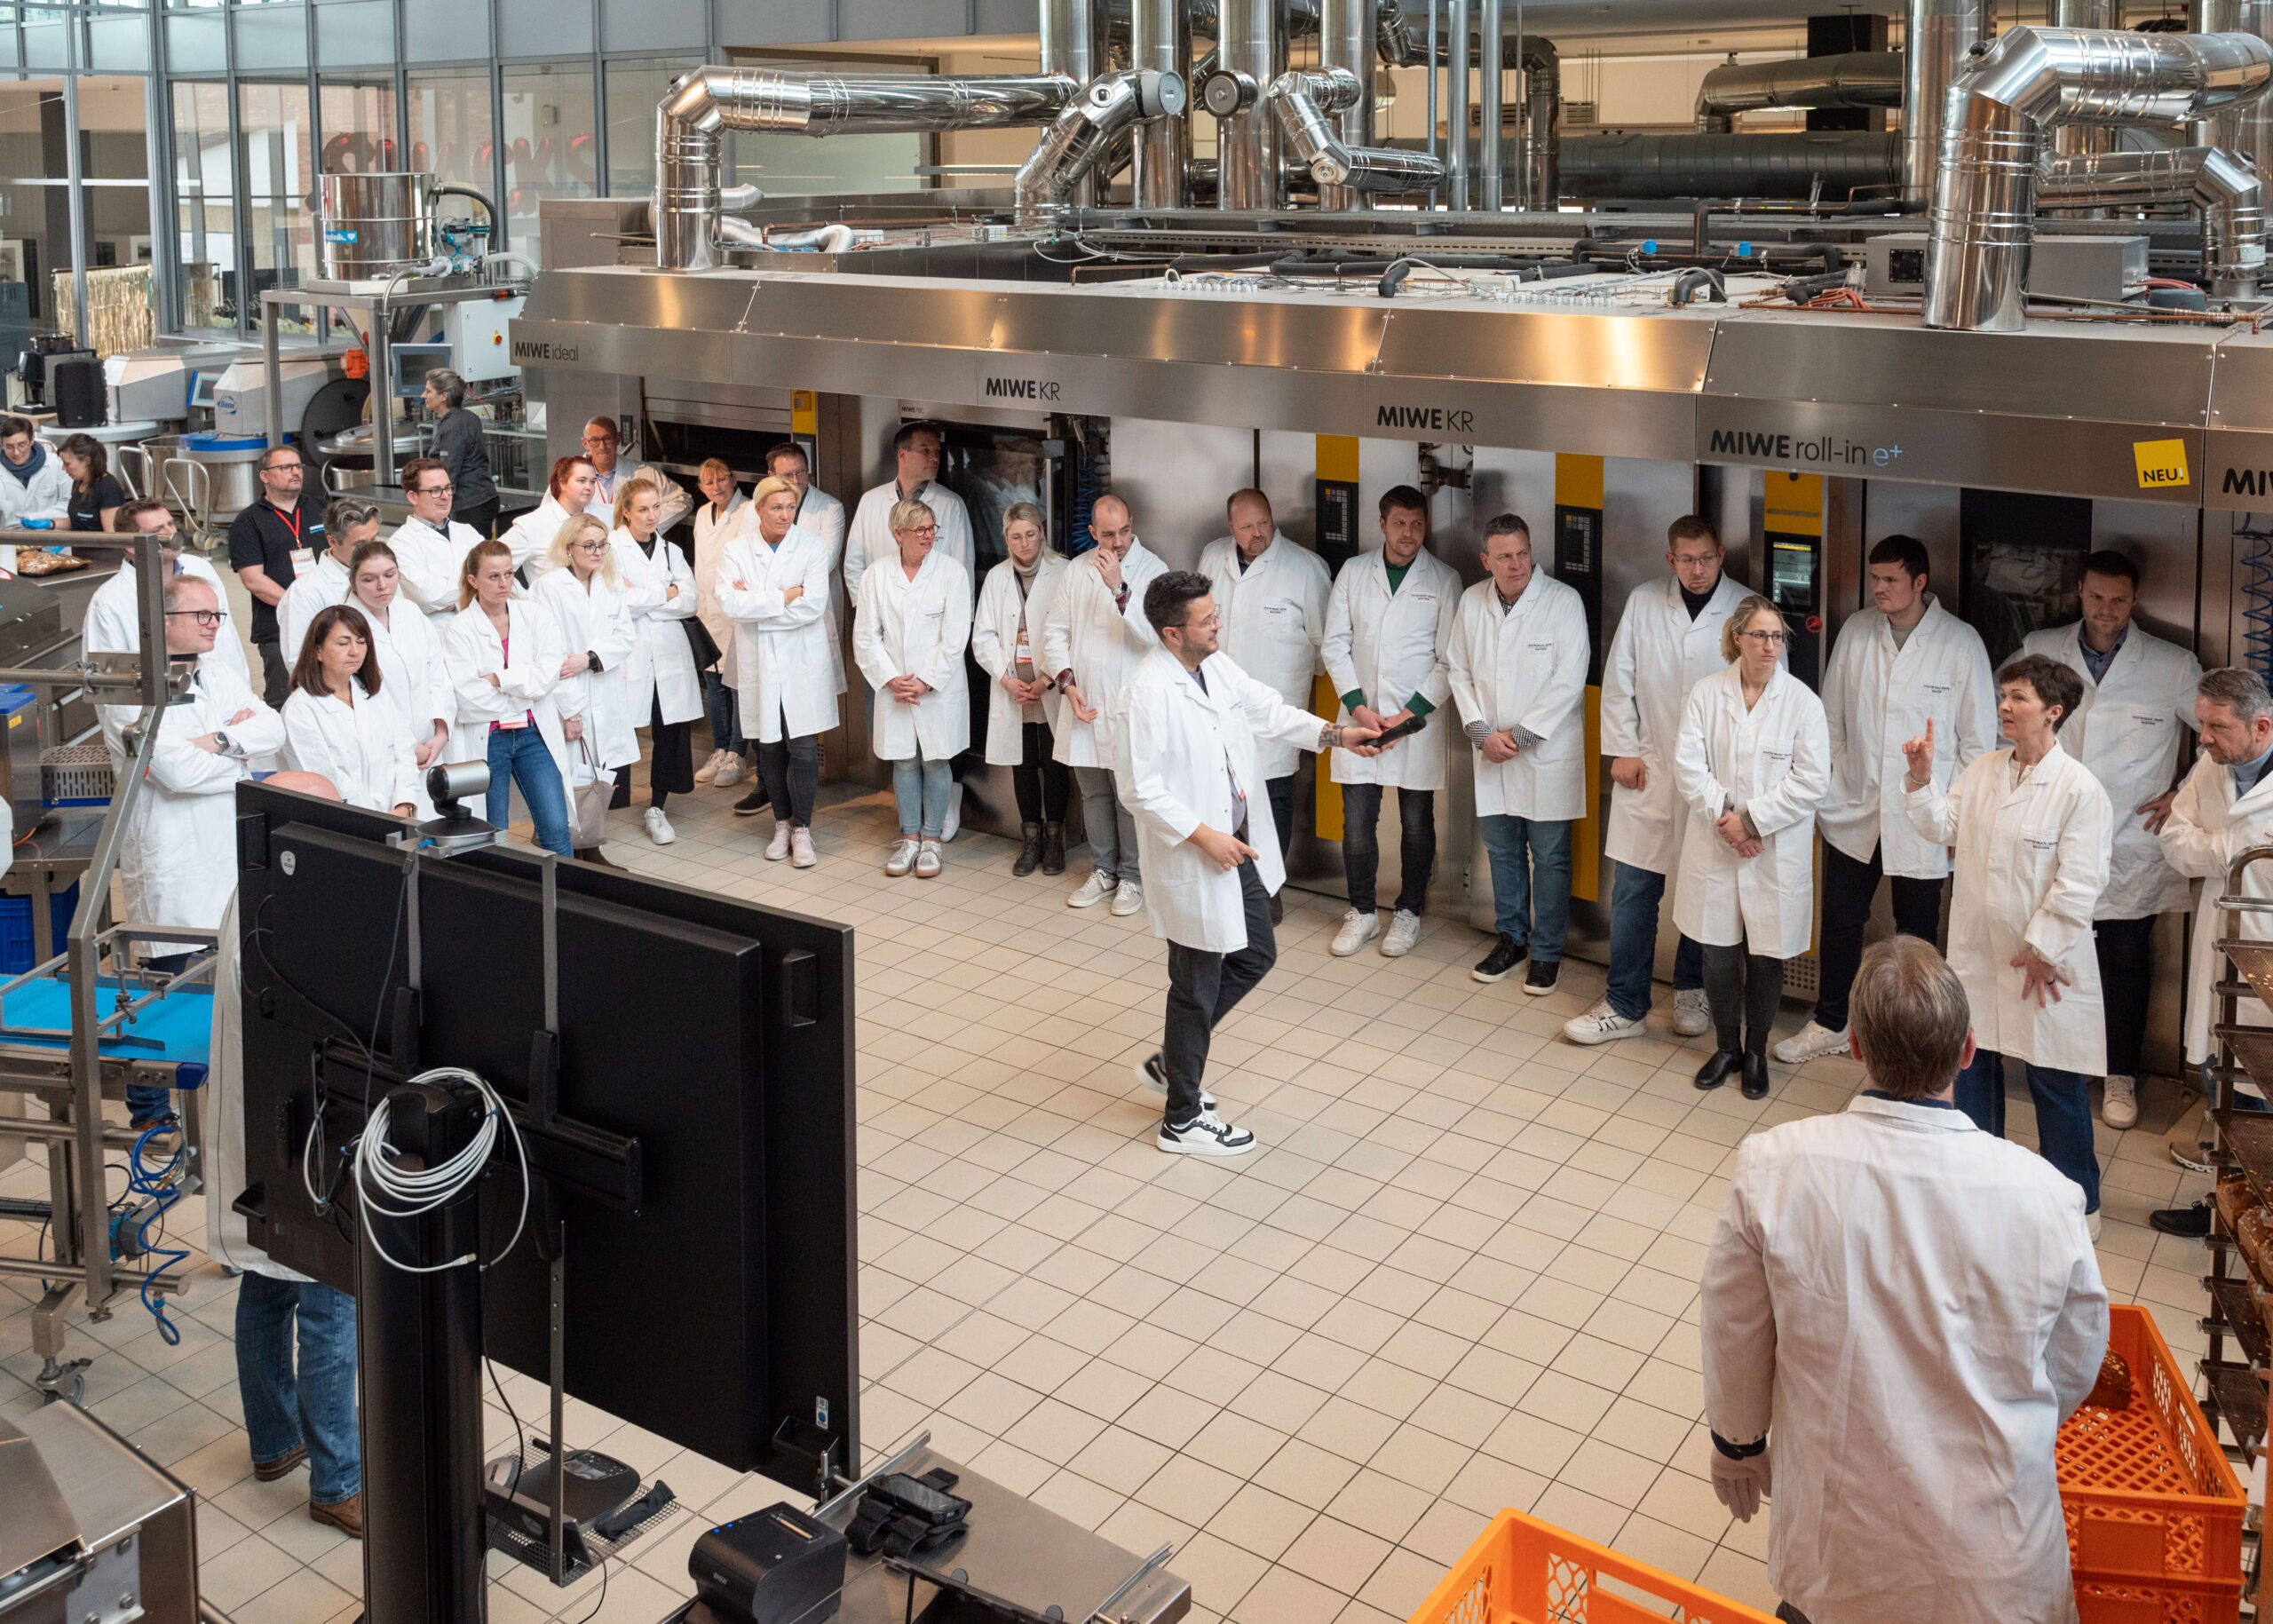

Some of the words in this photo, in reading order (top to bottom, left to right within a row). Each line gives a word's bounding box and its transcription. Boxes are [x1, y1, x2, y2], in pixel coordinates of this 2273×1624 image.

[515, 341, 550, 360] MIWE
[551, 344, 579, 361] ideal
[986, 377, 1036, 399] MIWE
[1040, 382, 1060, 401] KR
[1377, 405, 1443, 431] MIWE
[1446, 409, 1474, 433] KR
[1710, 429, 1790, 459] MIWE
[1796, 436, 1866, 465] roll-in
[2142, 466, 2184, 483] NEU!
[2222, 467, 2273, 496] MI
